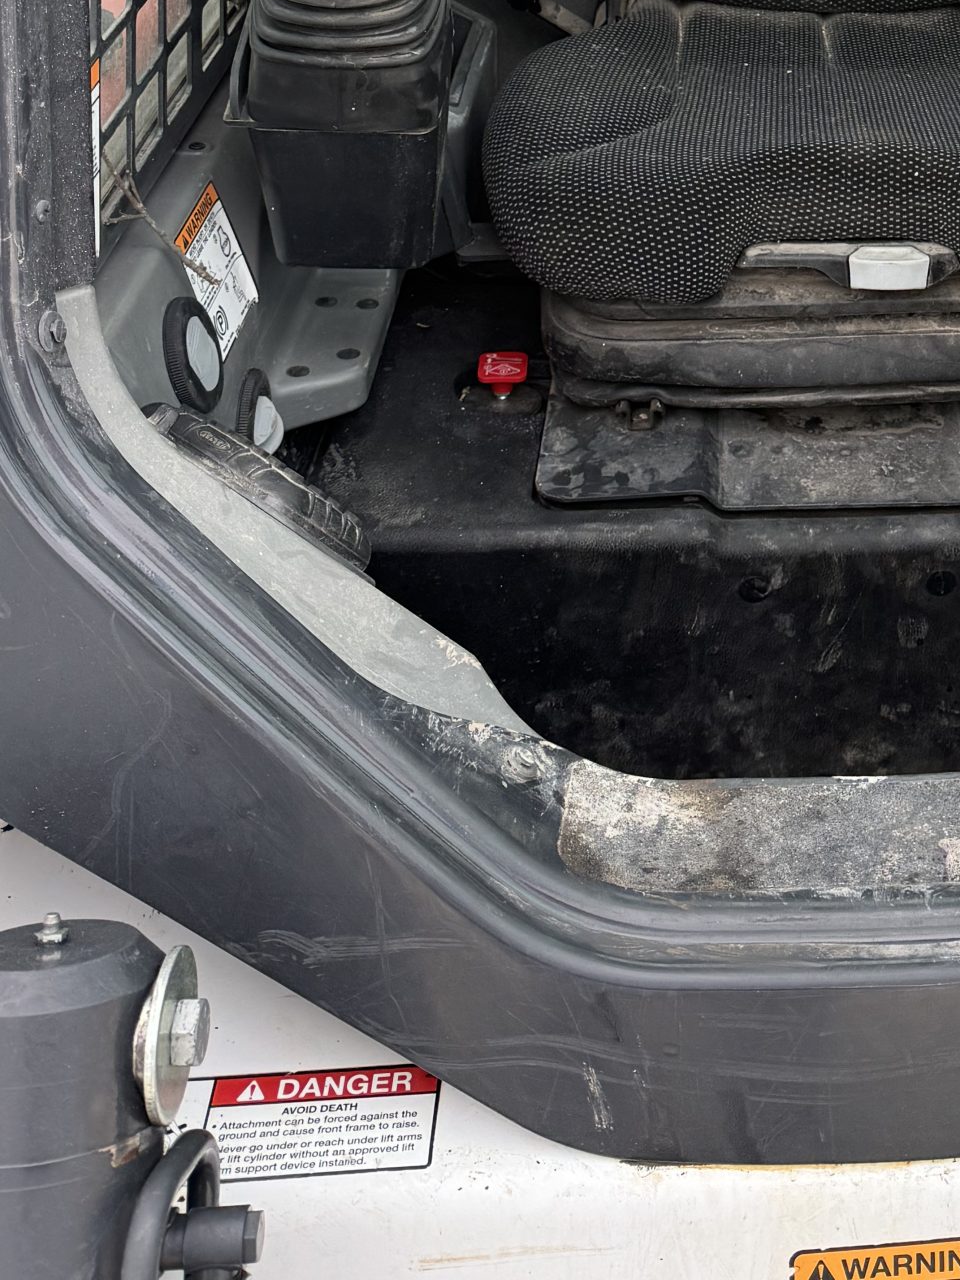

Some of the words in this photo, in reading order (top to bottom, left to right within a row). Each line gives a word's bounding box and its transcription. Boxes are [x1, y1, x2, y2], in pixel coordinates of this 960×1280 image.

[186, 193, 213, 240] WARNING
[277, 1071, 411, 1099] DANGER
[281, 1105, 317, 1115] AVOID
[320, 1103, 358, 1113] DEATH
[220, 1119, 281, 1130] Attachment
[284, 1118, 304, 1126] can
[307, 1116, 320, 1124] be
[324, 1114, 357, 1123] forced
[360, 1111, 398, 1122] against
[402, 1110, 417, 1118] the
[218, 1131, 256, 1142] ground
[260, 1129, 280, 1137] and
[283, 1128, 314, 1136] cause
[318, 1125, 342, 1134] front
[345, 1123, 375, 1132] frame
[392, 1120, 419, 1128] raise.
[249, 1145, 263, 1153] go
[266, 1142, 298, 1150] under
[314, 1138, 344, 1147] reach
[347, 1136, 378, 1145] under
[381, 1135, 394, 1143] lift
[396, 1133, 422, 1141] arms
[227, 1155, 240, 1163] lift
[244, 1152, 286, 1164] cylinder
[290, 1149, 328, 1159] without
[332, 1148, 345, 1156] an
[348, 1144, 399, 1155] approved
[402, 1143, 415, 1151] lift
[235, 1163, 277, 1175] support
[280, 1161, 315, 1170] device
